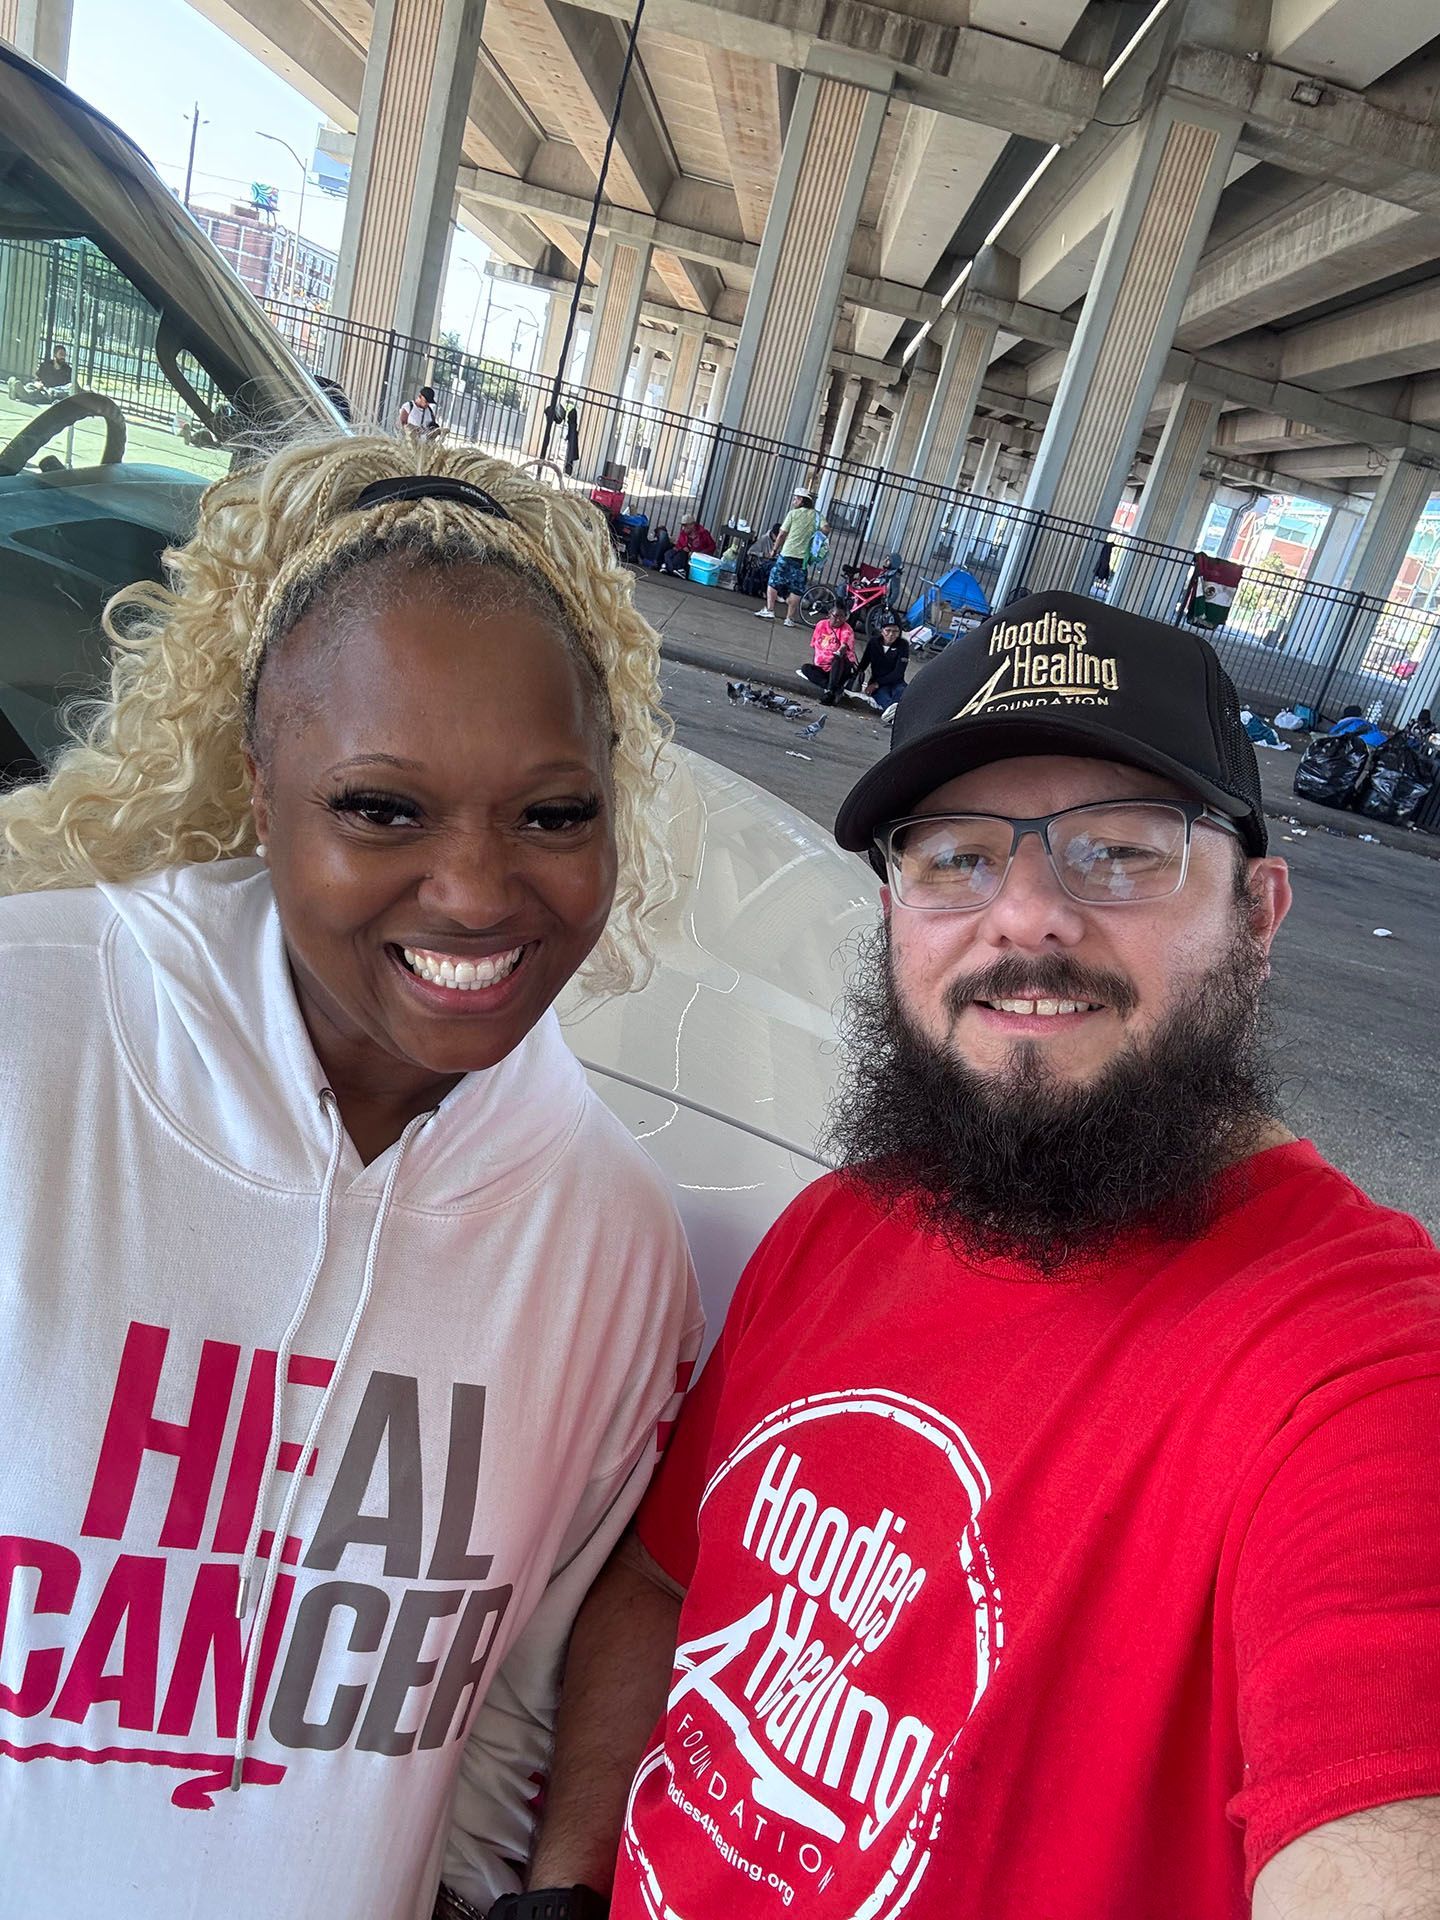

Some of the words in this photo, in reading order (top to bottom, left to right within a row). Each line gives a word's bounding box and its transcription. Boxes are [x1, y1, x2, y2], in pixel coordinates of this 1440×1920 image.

[986, 696, 1109, 713] FOUNDATION
[988, 611, 1088, 656] Hoodies
[1013, 644, 1119, 691] Healing
[80, 1321, 495, 1581] HEAL
[742, 1444, 927, 1652] Hoodies
[0, 1535, 513, 1757] CANCER
[743, 1583, 935, 1851] Healing
[667, 1780, 795, 1907] odies4Healing.org
[676, 1713, 835, 1895] FOUNDATION
